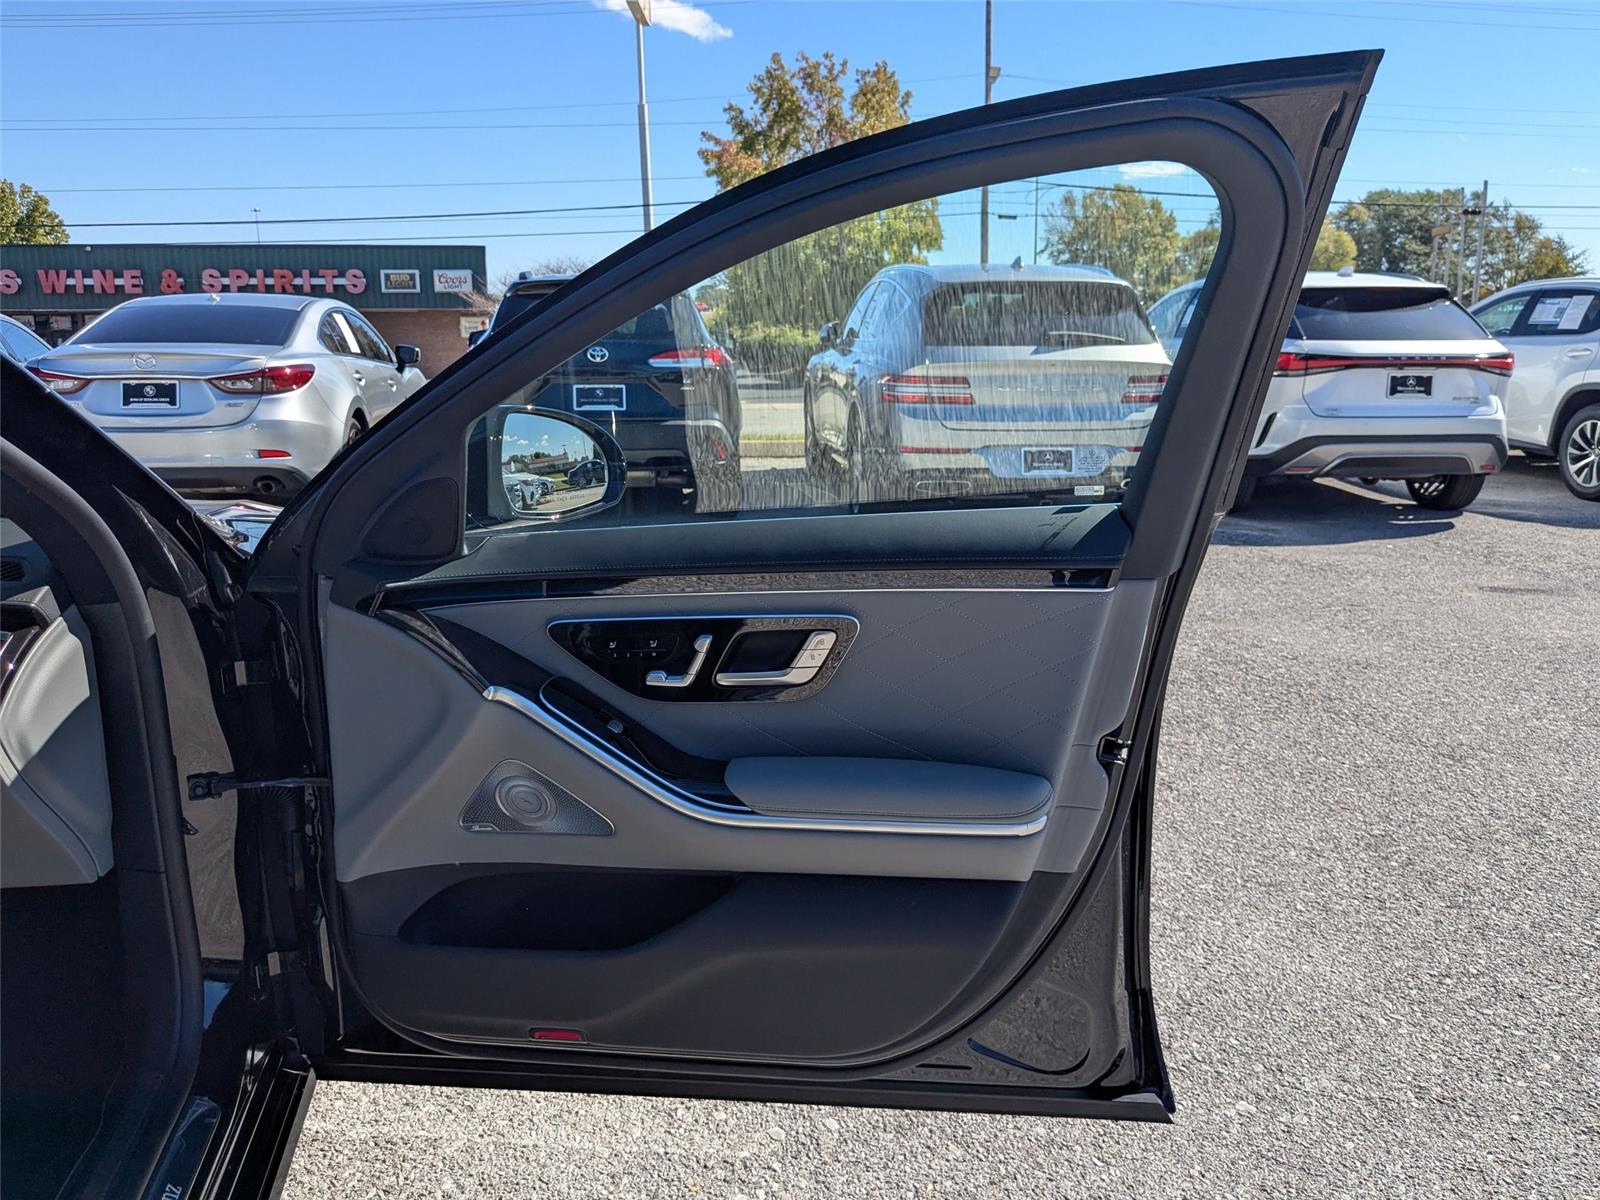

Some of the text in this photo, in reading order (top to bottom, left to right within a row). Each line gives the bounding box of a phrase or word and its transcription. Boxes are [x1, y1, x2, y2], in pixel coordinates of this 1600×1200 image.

[37, 269, 143, 294] WINE
[160, 268, 183, 293] &
[202, 268, 366, 294] SPIRITS
[438, 272, 467, 284] Coors
